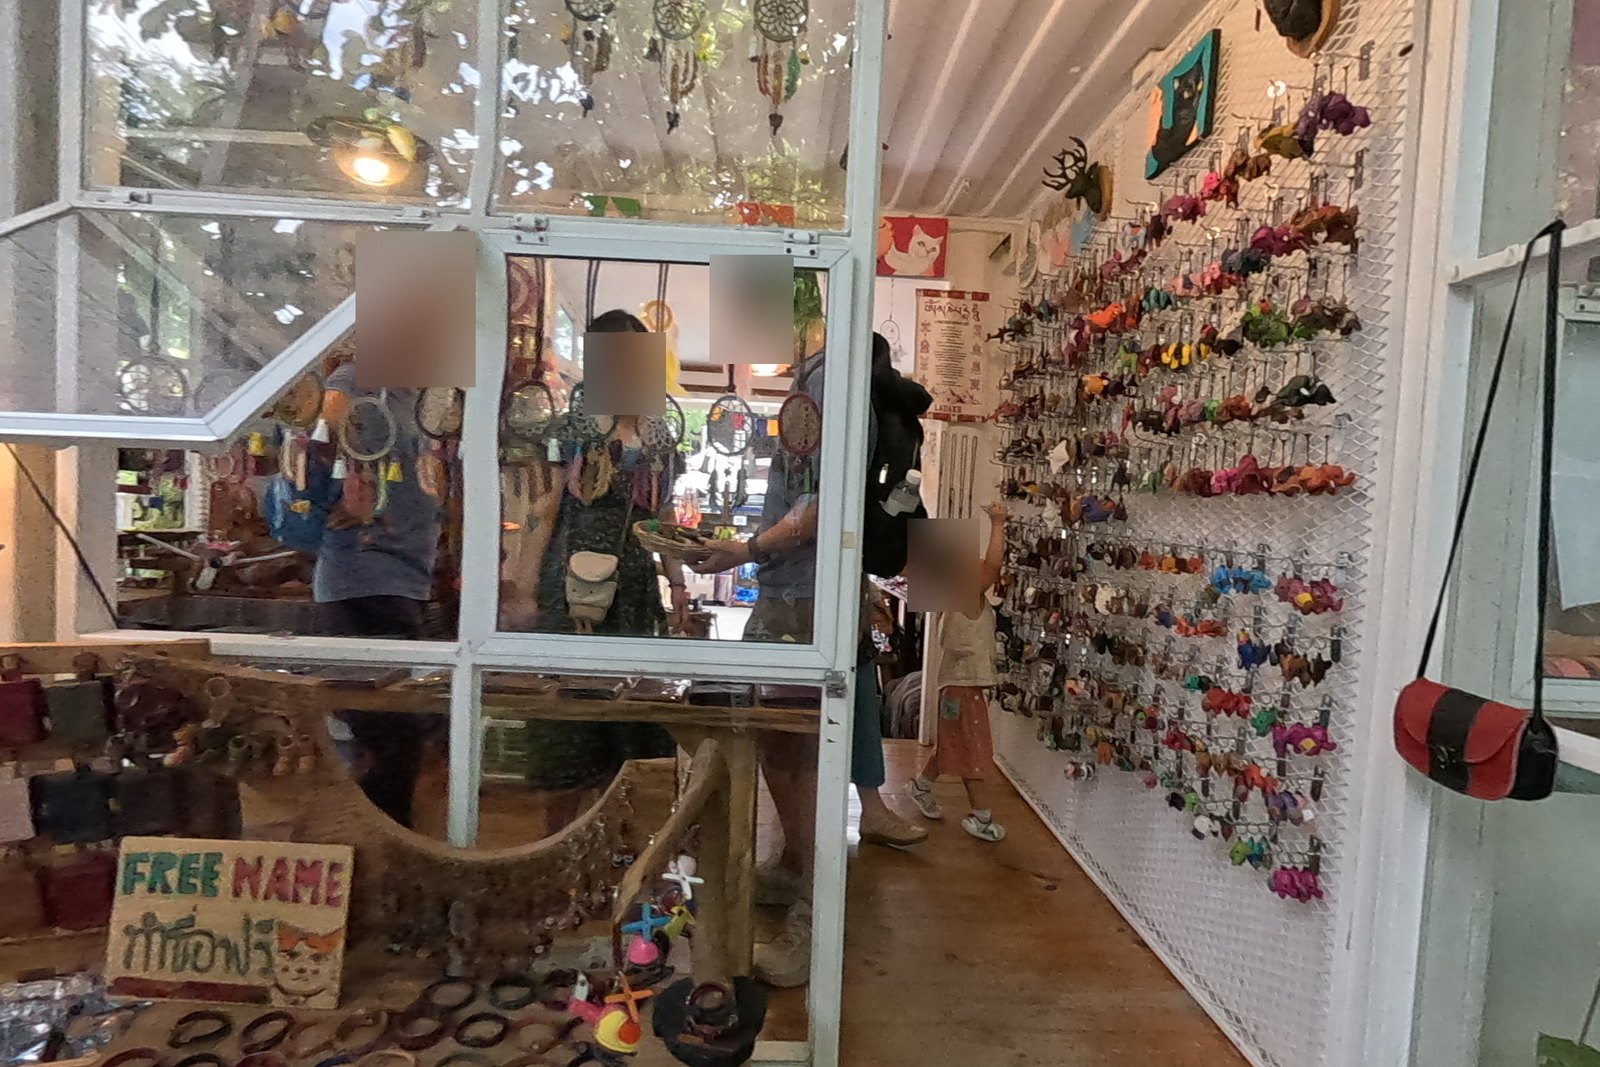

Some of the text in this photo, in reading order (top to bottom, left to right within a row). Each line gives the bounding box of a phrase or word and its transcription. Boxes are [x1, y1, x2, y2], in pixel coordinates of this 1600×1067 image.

[934, 404, 962, 413] LADAKH
[121, 852, 344, 907] FREE NAME
